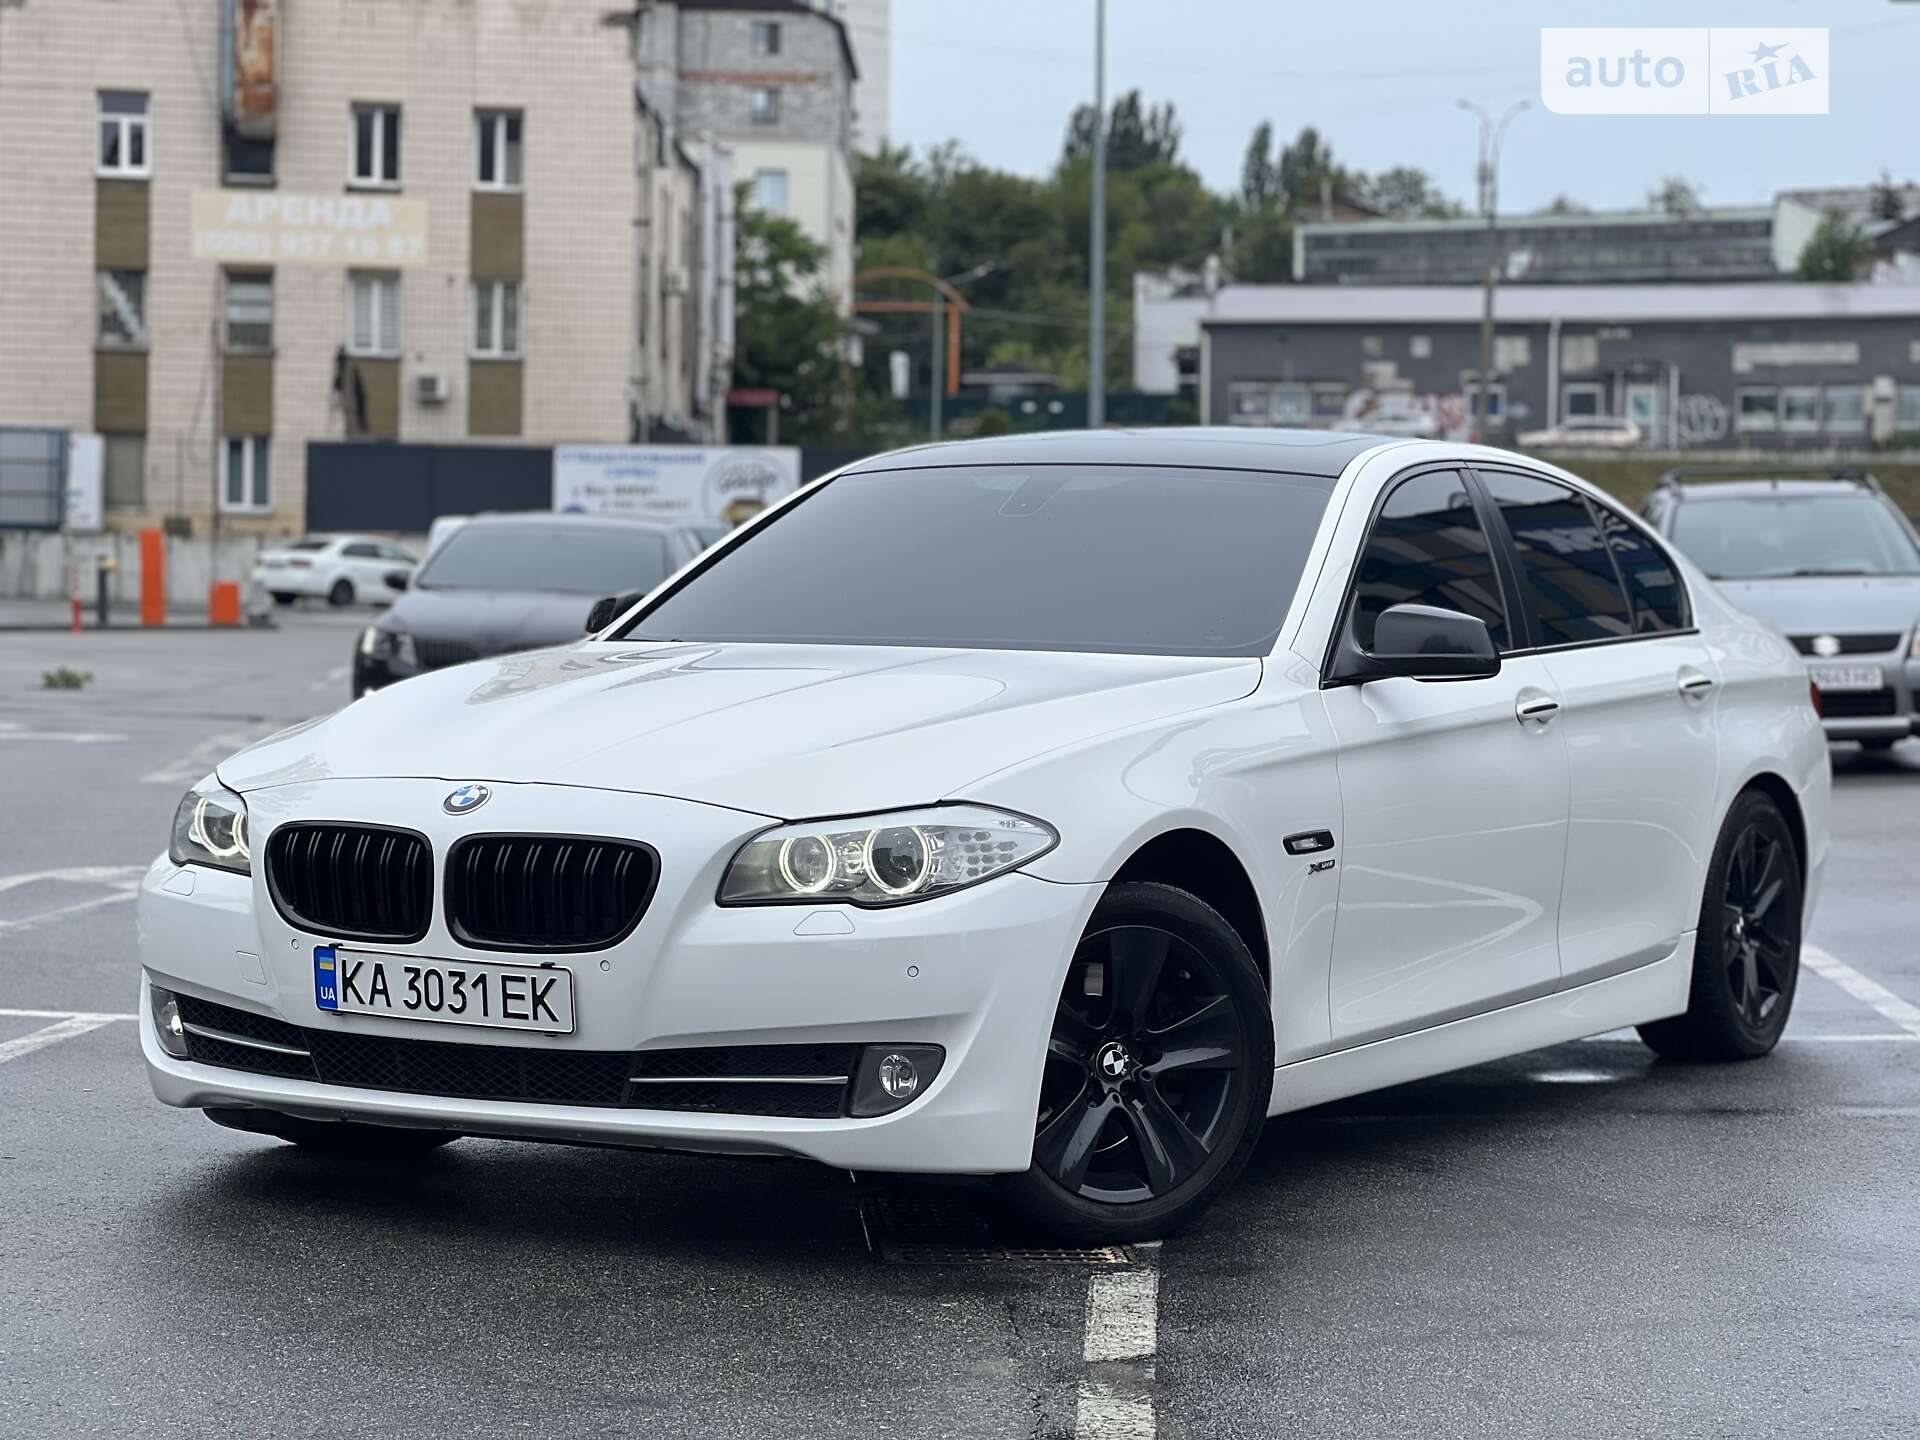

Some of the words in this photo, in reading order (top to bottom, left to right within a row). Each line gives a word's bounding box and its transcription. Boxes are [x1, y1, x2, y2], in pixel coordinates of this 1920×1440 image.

[226, 195, 393, 230] АРЕНДА
[320, 987, 335, 1001] UA
[341, 959, 392, 1007] KA
[403, 966, 488, 1017] 3031
[501, 975, 559, 1023] EK
